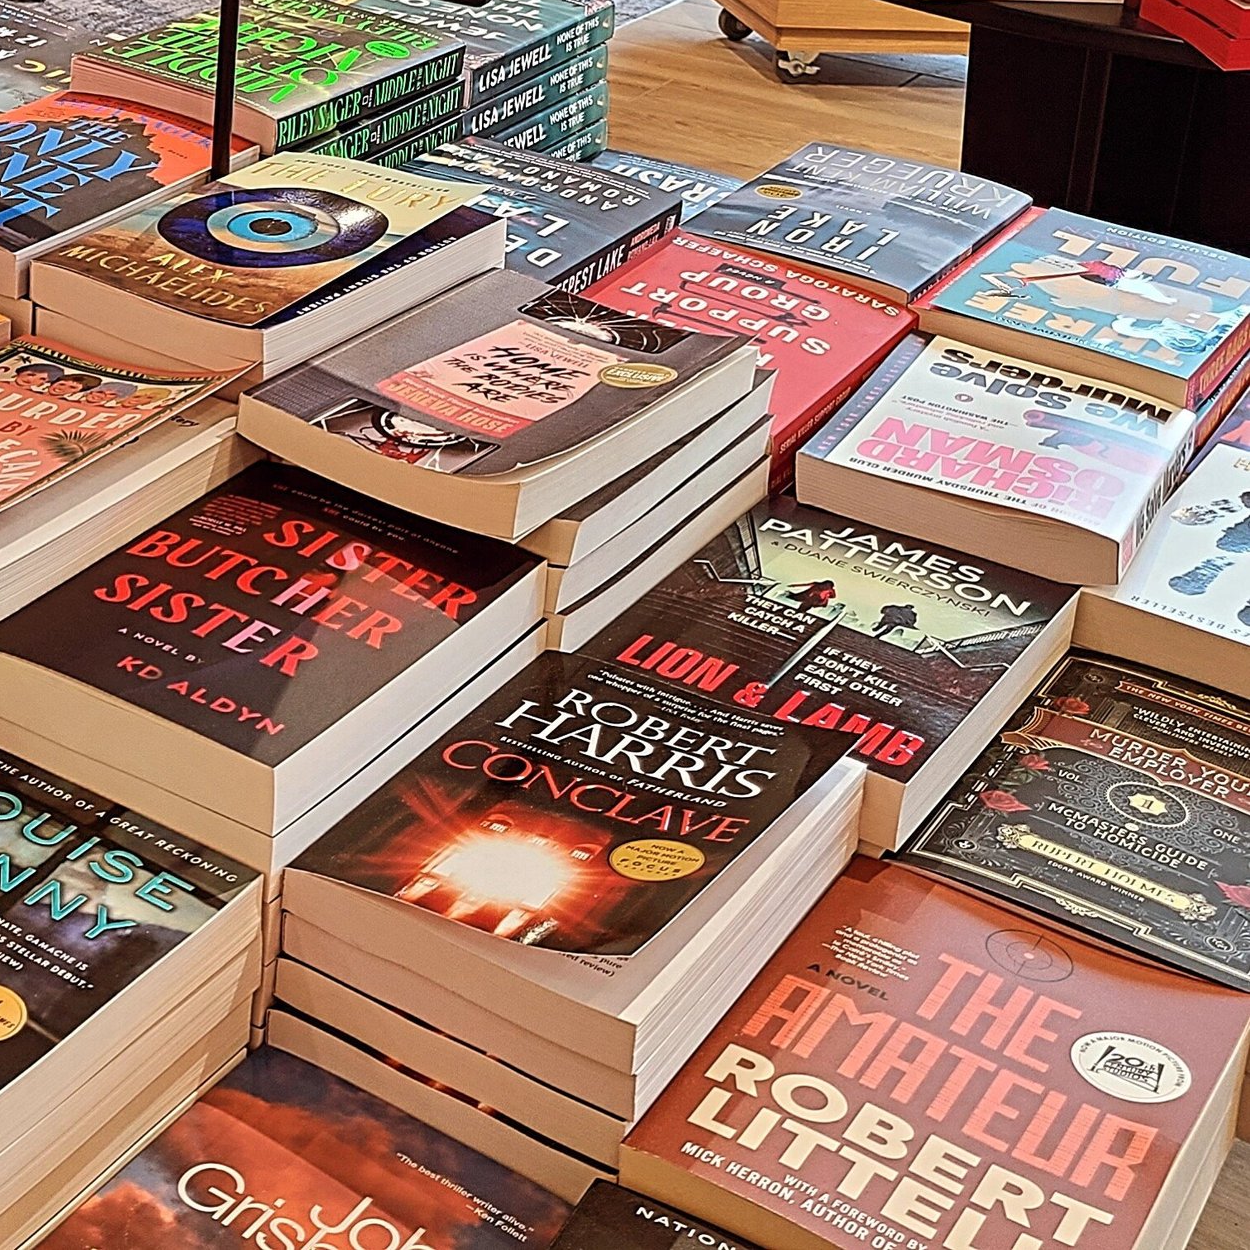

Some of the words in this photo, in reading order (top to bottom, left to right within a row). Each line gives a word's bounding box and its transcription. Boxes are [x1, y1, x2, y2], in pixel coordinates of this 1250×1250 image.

[478, 69, 506, 93] LISA
[508, 44, 552, 78] JEWELL
[277, 106, 318, 148] RILEY
[318, 92, 361, 133] SAGER
[251, 161, 334, 191] THE
[340, 178, 455, 211] FURY
[746, 221, 881, 260] IRON
[768, 205, 900, 247] LAKE
[59, 245, 273, 314] MICHAELIDES
[149, 252, 233, 283] ALEX
[680, 270, 830, 322] GROUP
[622, 284, 829, 355] SUPPORT
[471, 373, 566, 404] BODIES
[484, 362, 576, 392] WHERE
[487, 346, 591, 380] HOME
[871, 416, 1125, 497] OSMAN
[263, 518, 478, 621] SISTER
[759, 518, 1031, 617] PATTERSON
[823, 524, 983, 584] JAMES
[127, 530, 403, 651] BUTCHER
[94, 573, 320, 679] SISTER
[116, 655, 163, 681] KD
[166, 681, 285, 737] ALDYN
[553, 688, 777, 769] ROBERT
[618, 634, 740, 693] LION
[733, 681, 766, 708] &
[774, 689, 925, 767] LAMB
[495, 699, 778, 801] HARRIS
[1090, 728, 1188, 771] MURDER
[1107, 747, 1231, 799] EMPLOYER
[442, 740, 750, 843] CONCLAVE
[1091, 828, 1181, 870] HOMICIDE
[916, 954, 1082, 1072] THE
[741, 974, 1159, 1201] AMATEUR
[705, 1042, 1114, 1246] ROBERT
